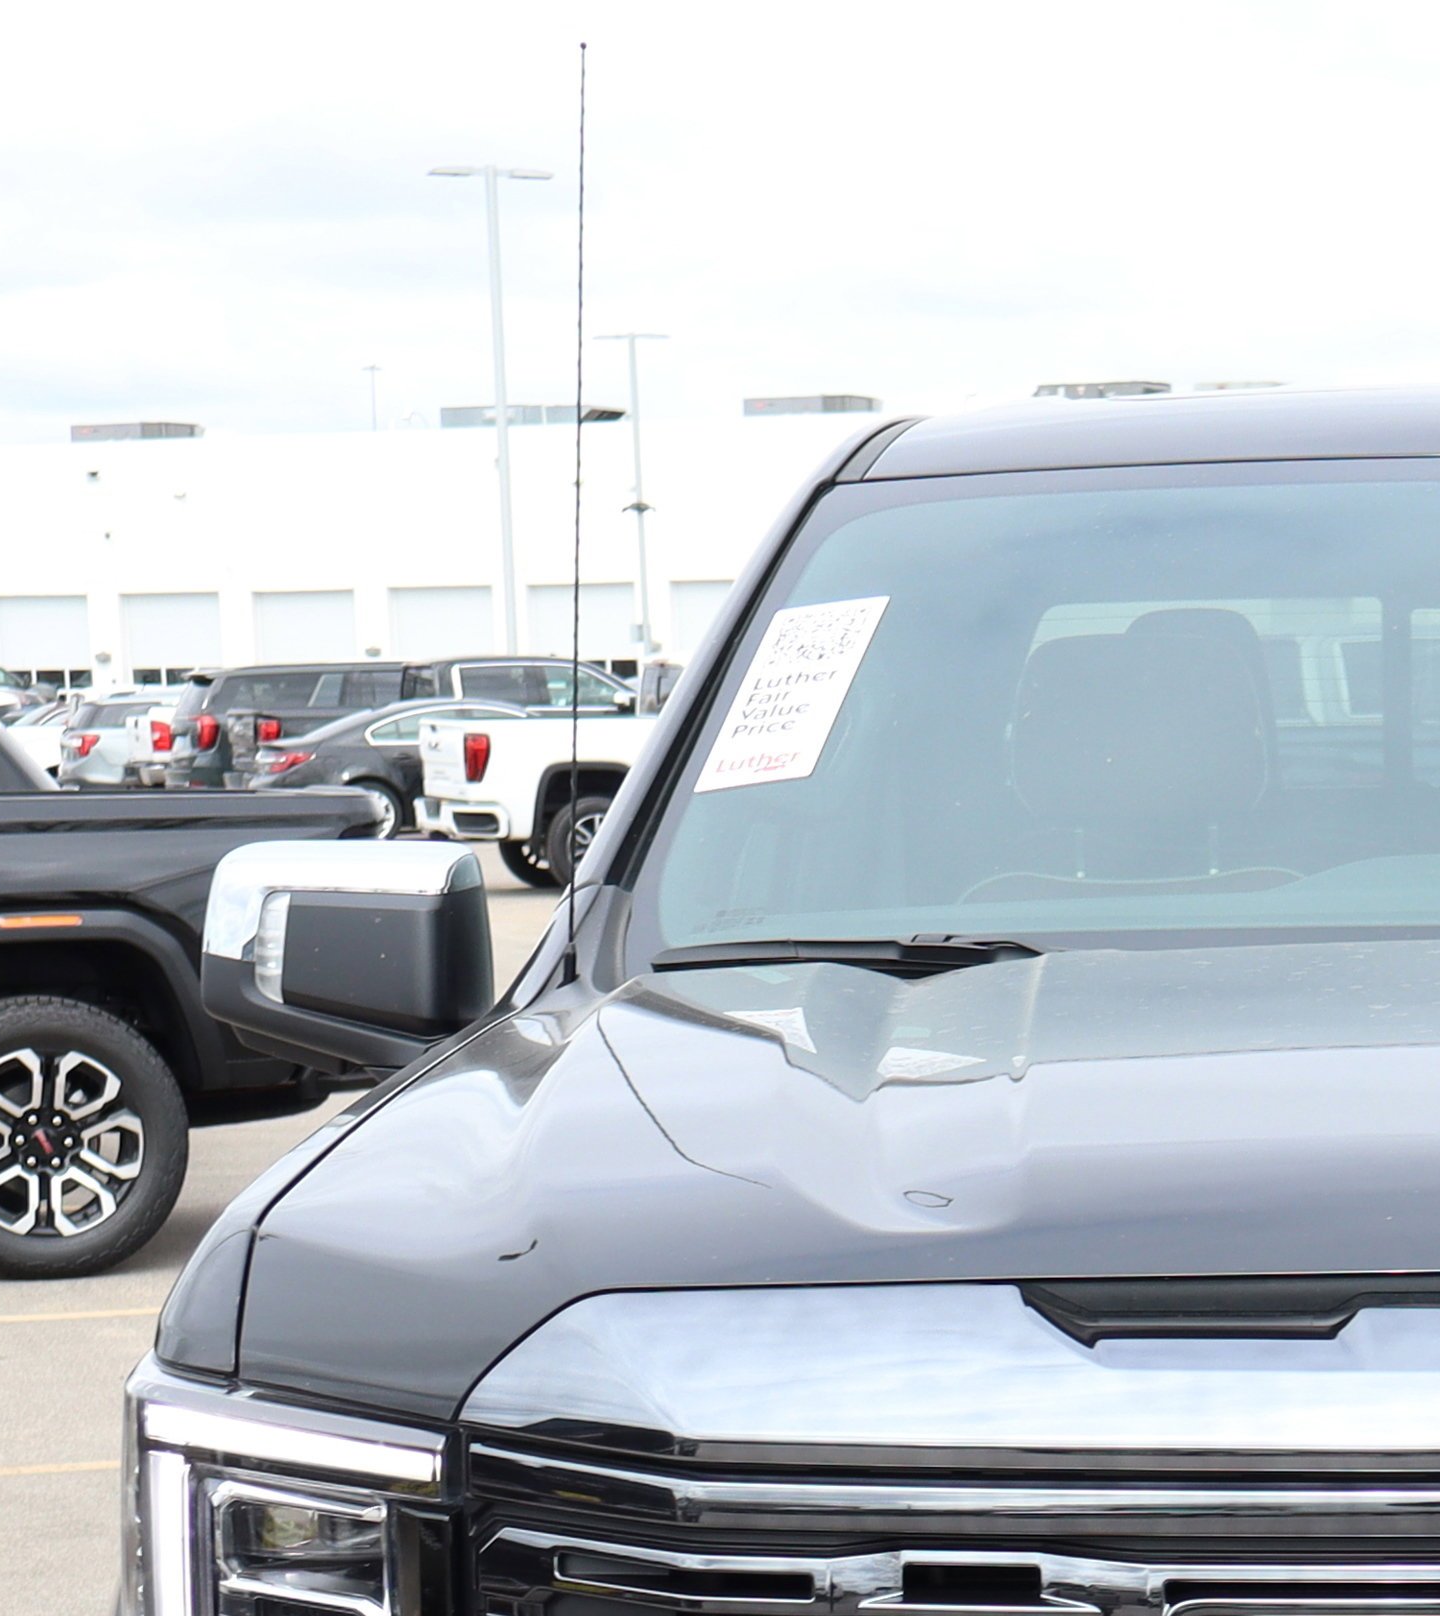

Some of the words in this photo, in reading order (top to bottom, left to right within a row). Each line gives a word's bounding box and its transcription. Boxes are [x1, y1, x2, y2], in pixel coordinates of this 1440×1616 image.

[753, 669, 839, 691] Luther
[746, 690, 791, 707] Fair
[741, 702, 811, 721] Value
[730, 719, 796, 739] Price
[715, 751, 801, 773] Luther
